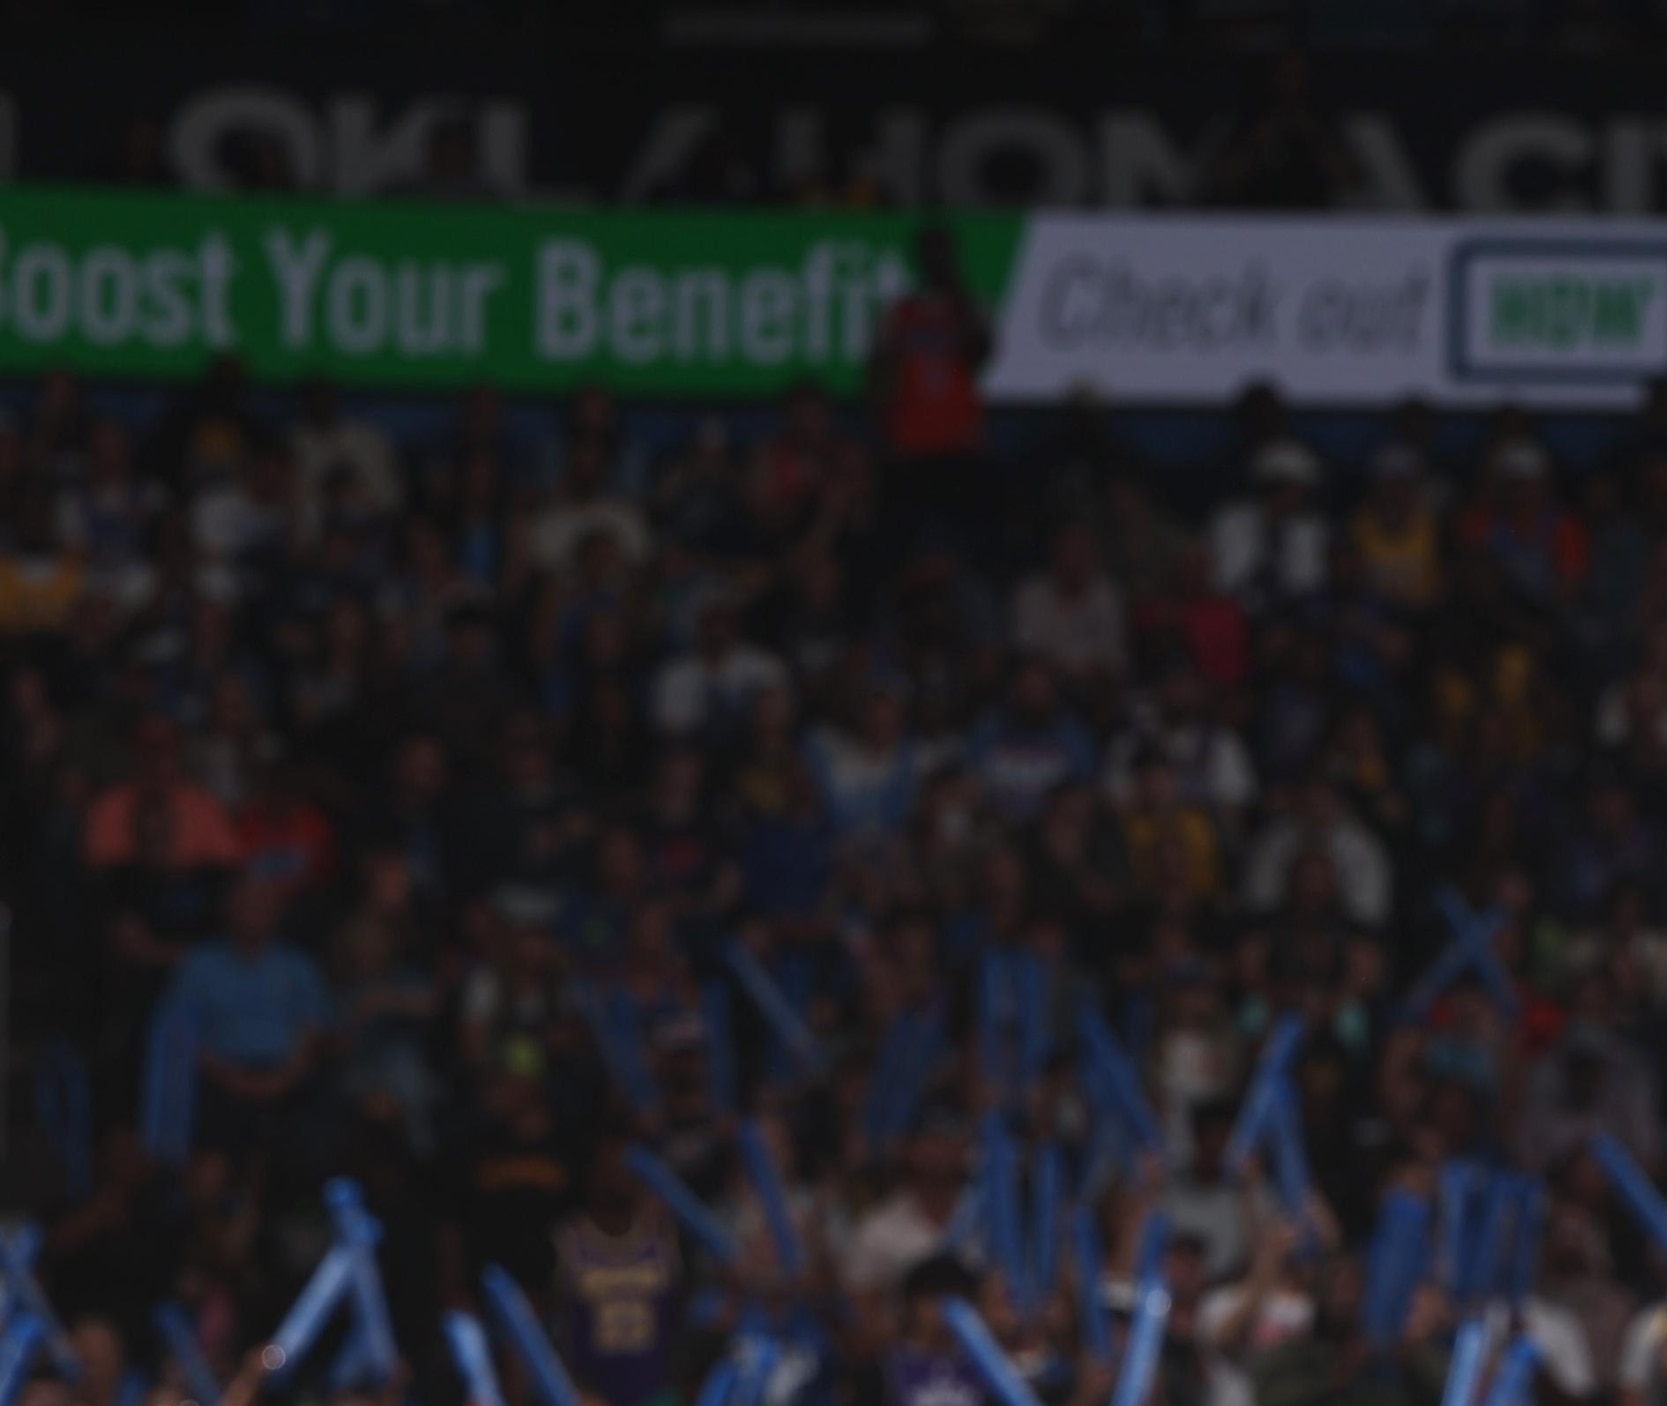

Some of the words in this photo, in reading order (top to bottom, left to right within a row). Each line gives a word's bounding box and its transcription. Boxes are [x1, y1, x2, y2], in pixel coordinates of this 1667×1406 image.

[265, 225, 508, 358] Your
[1040, 253, 1278, 352] Check
[1297, 262, 1434, 352] out
[1488, 275, 1658, 350] HOW
